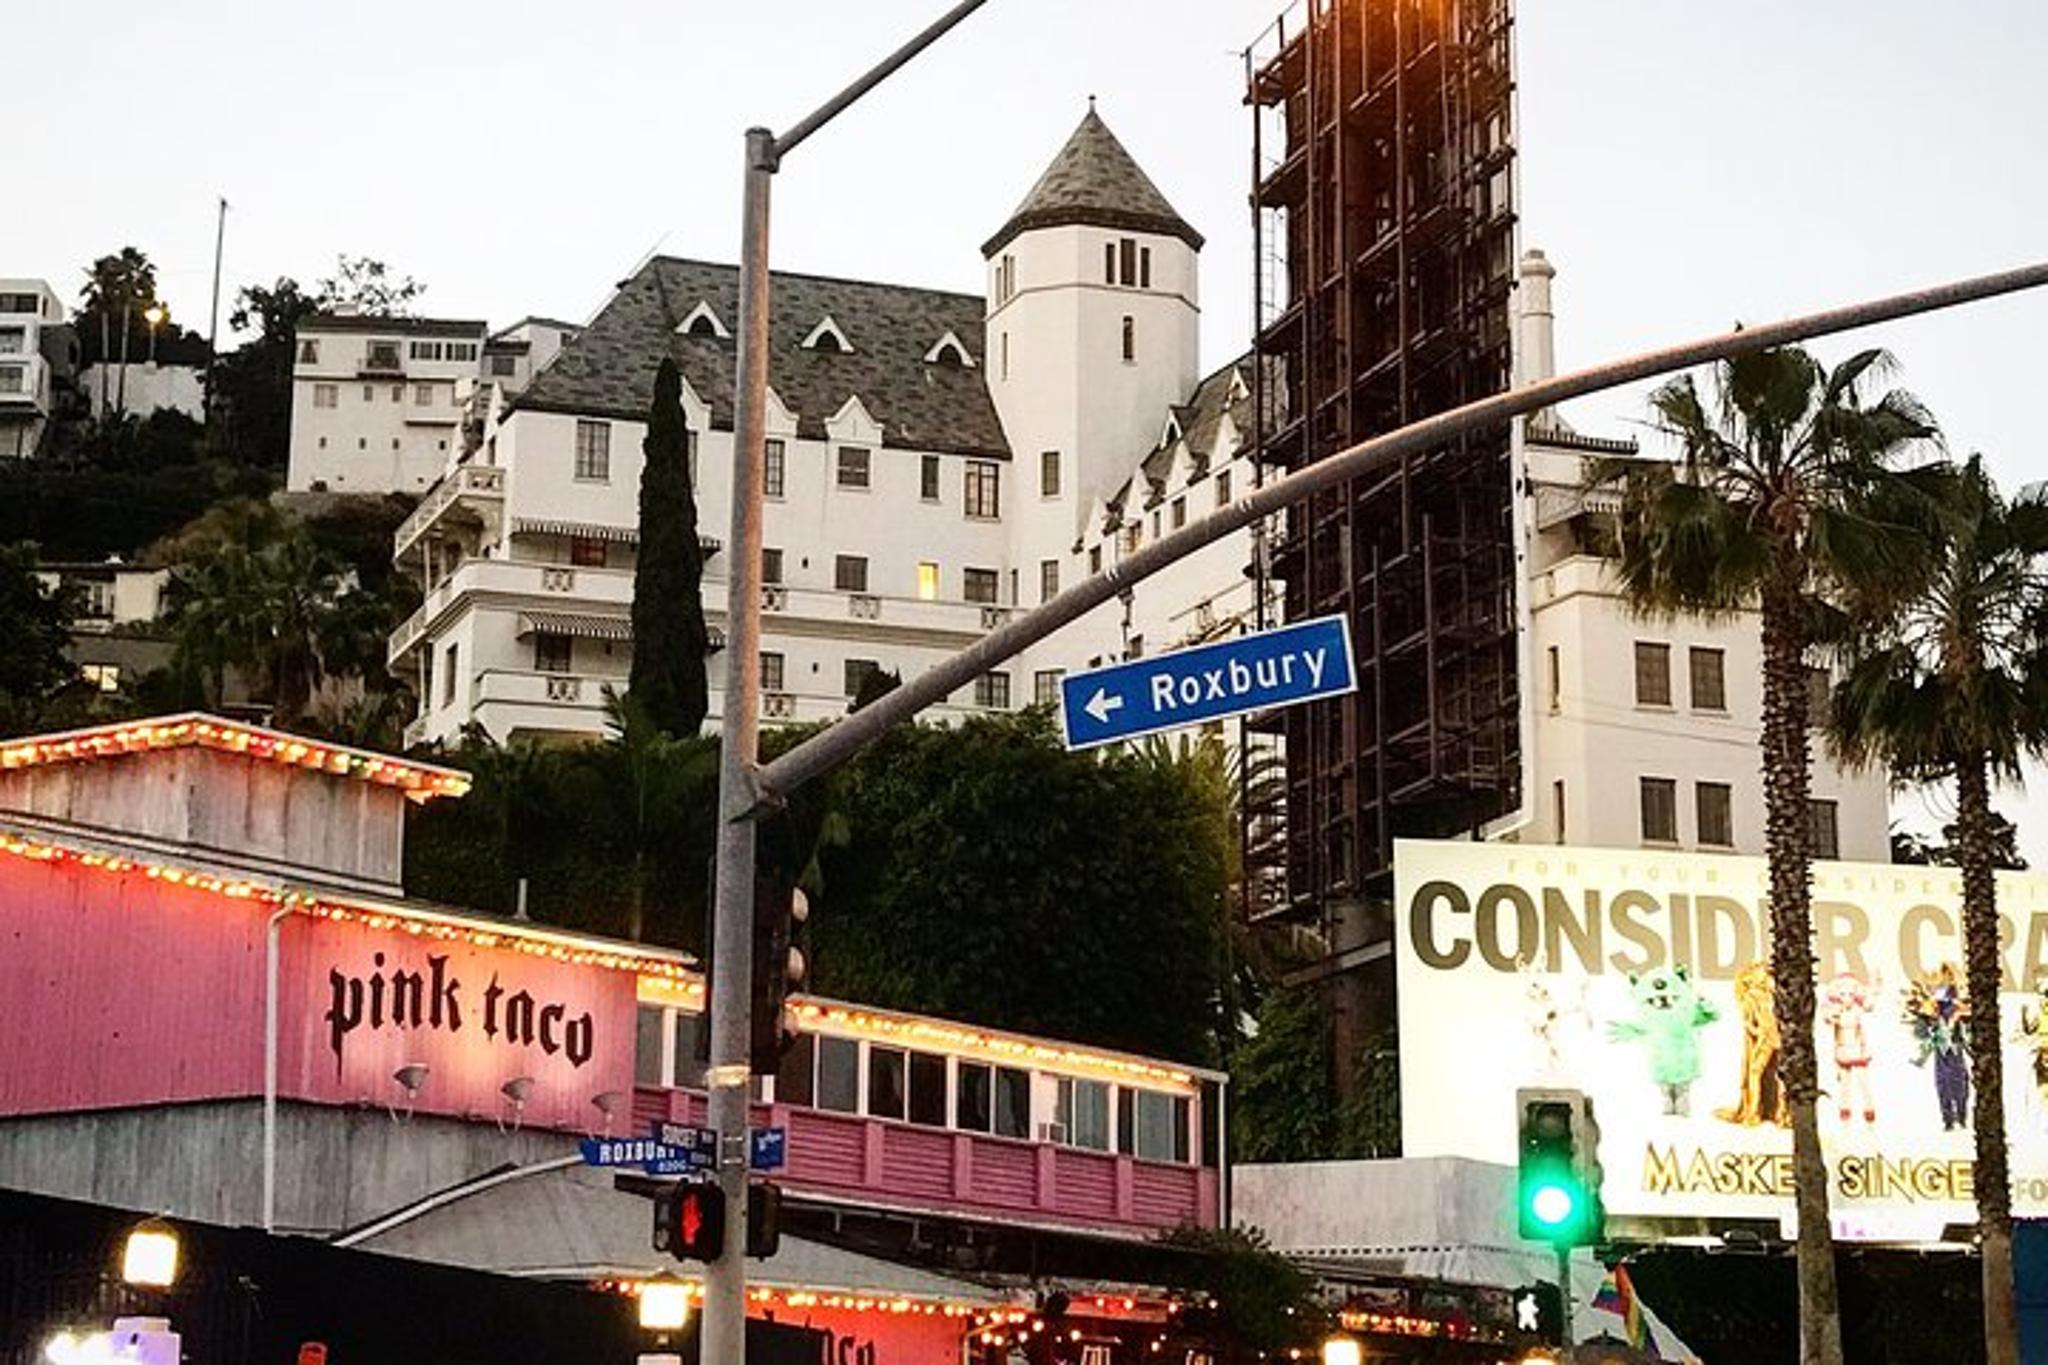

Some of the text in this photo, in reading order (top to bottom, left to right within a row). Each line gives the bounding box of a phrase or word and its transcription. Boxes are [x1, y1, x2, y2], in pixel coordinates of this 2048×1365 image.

[1151, 648, 1326, 712] Roxbury
[1409, 880, 1871, 985] CONSIDR
[325, 952, 593, 1084] pink taco
[1642, 1141, 1975, 1204] MASKE SINGE
[2016, 1177, 2048, 1201] FO
